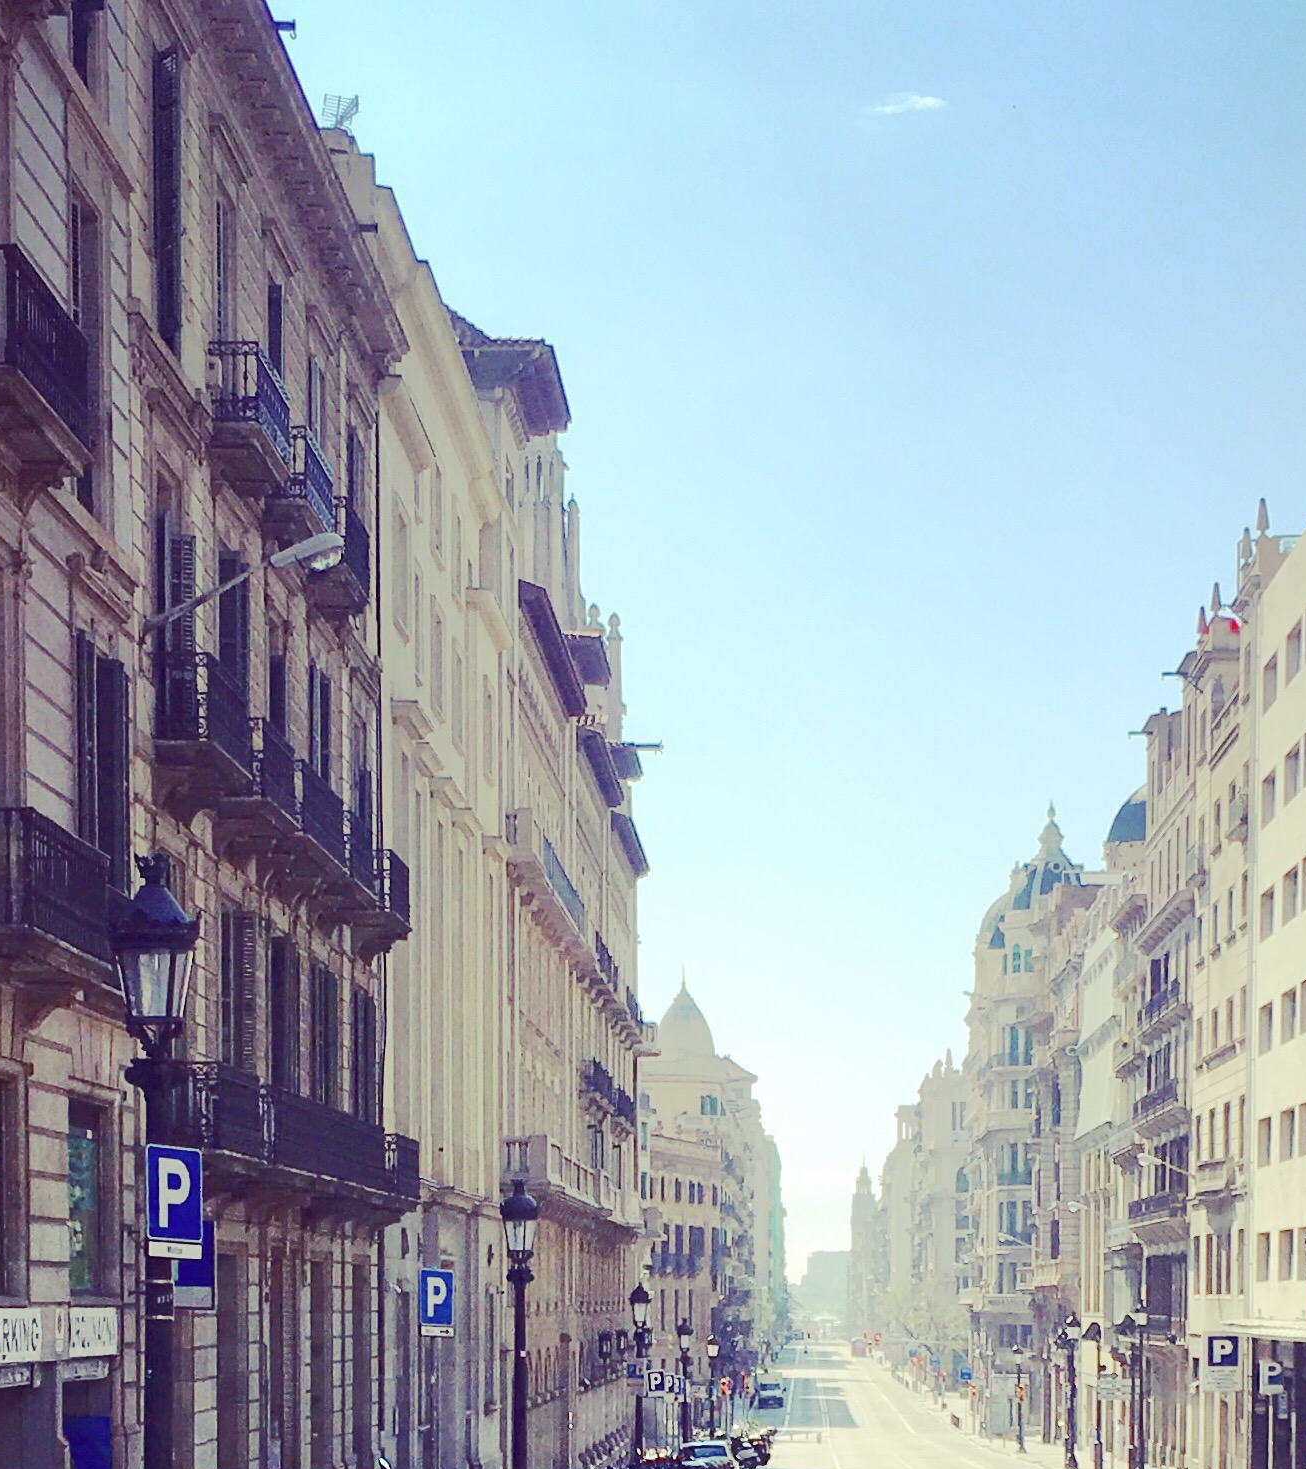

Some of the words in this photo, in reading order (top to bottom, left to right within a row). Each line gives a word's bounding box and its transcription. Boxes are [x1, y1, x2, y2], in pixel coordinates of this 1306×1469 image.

[158, 1157, 191, 1228] P
[427, 1276, 447, 1317] P
[1212, 1339, 1234, 1364] P
[650, 1372, 662, 1391] P
[1263, 1360, 1283, 1386] P
